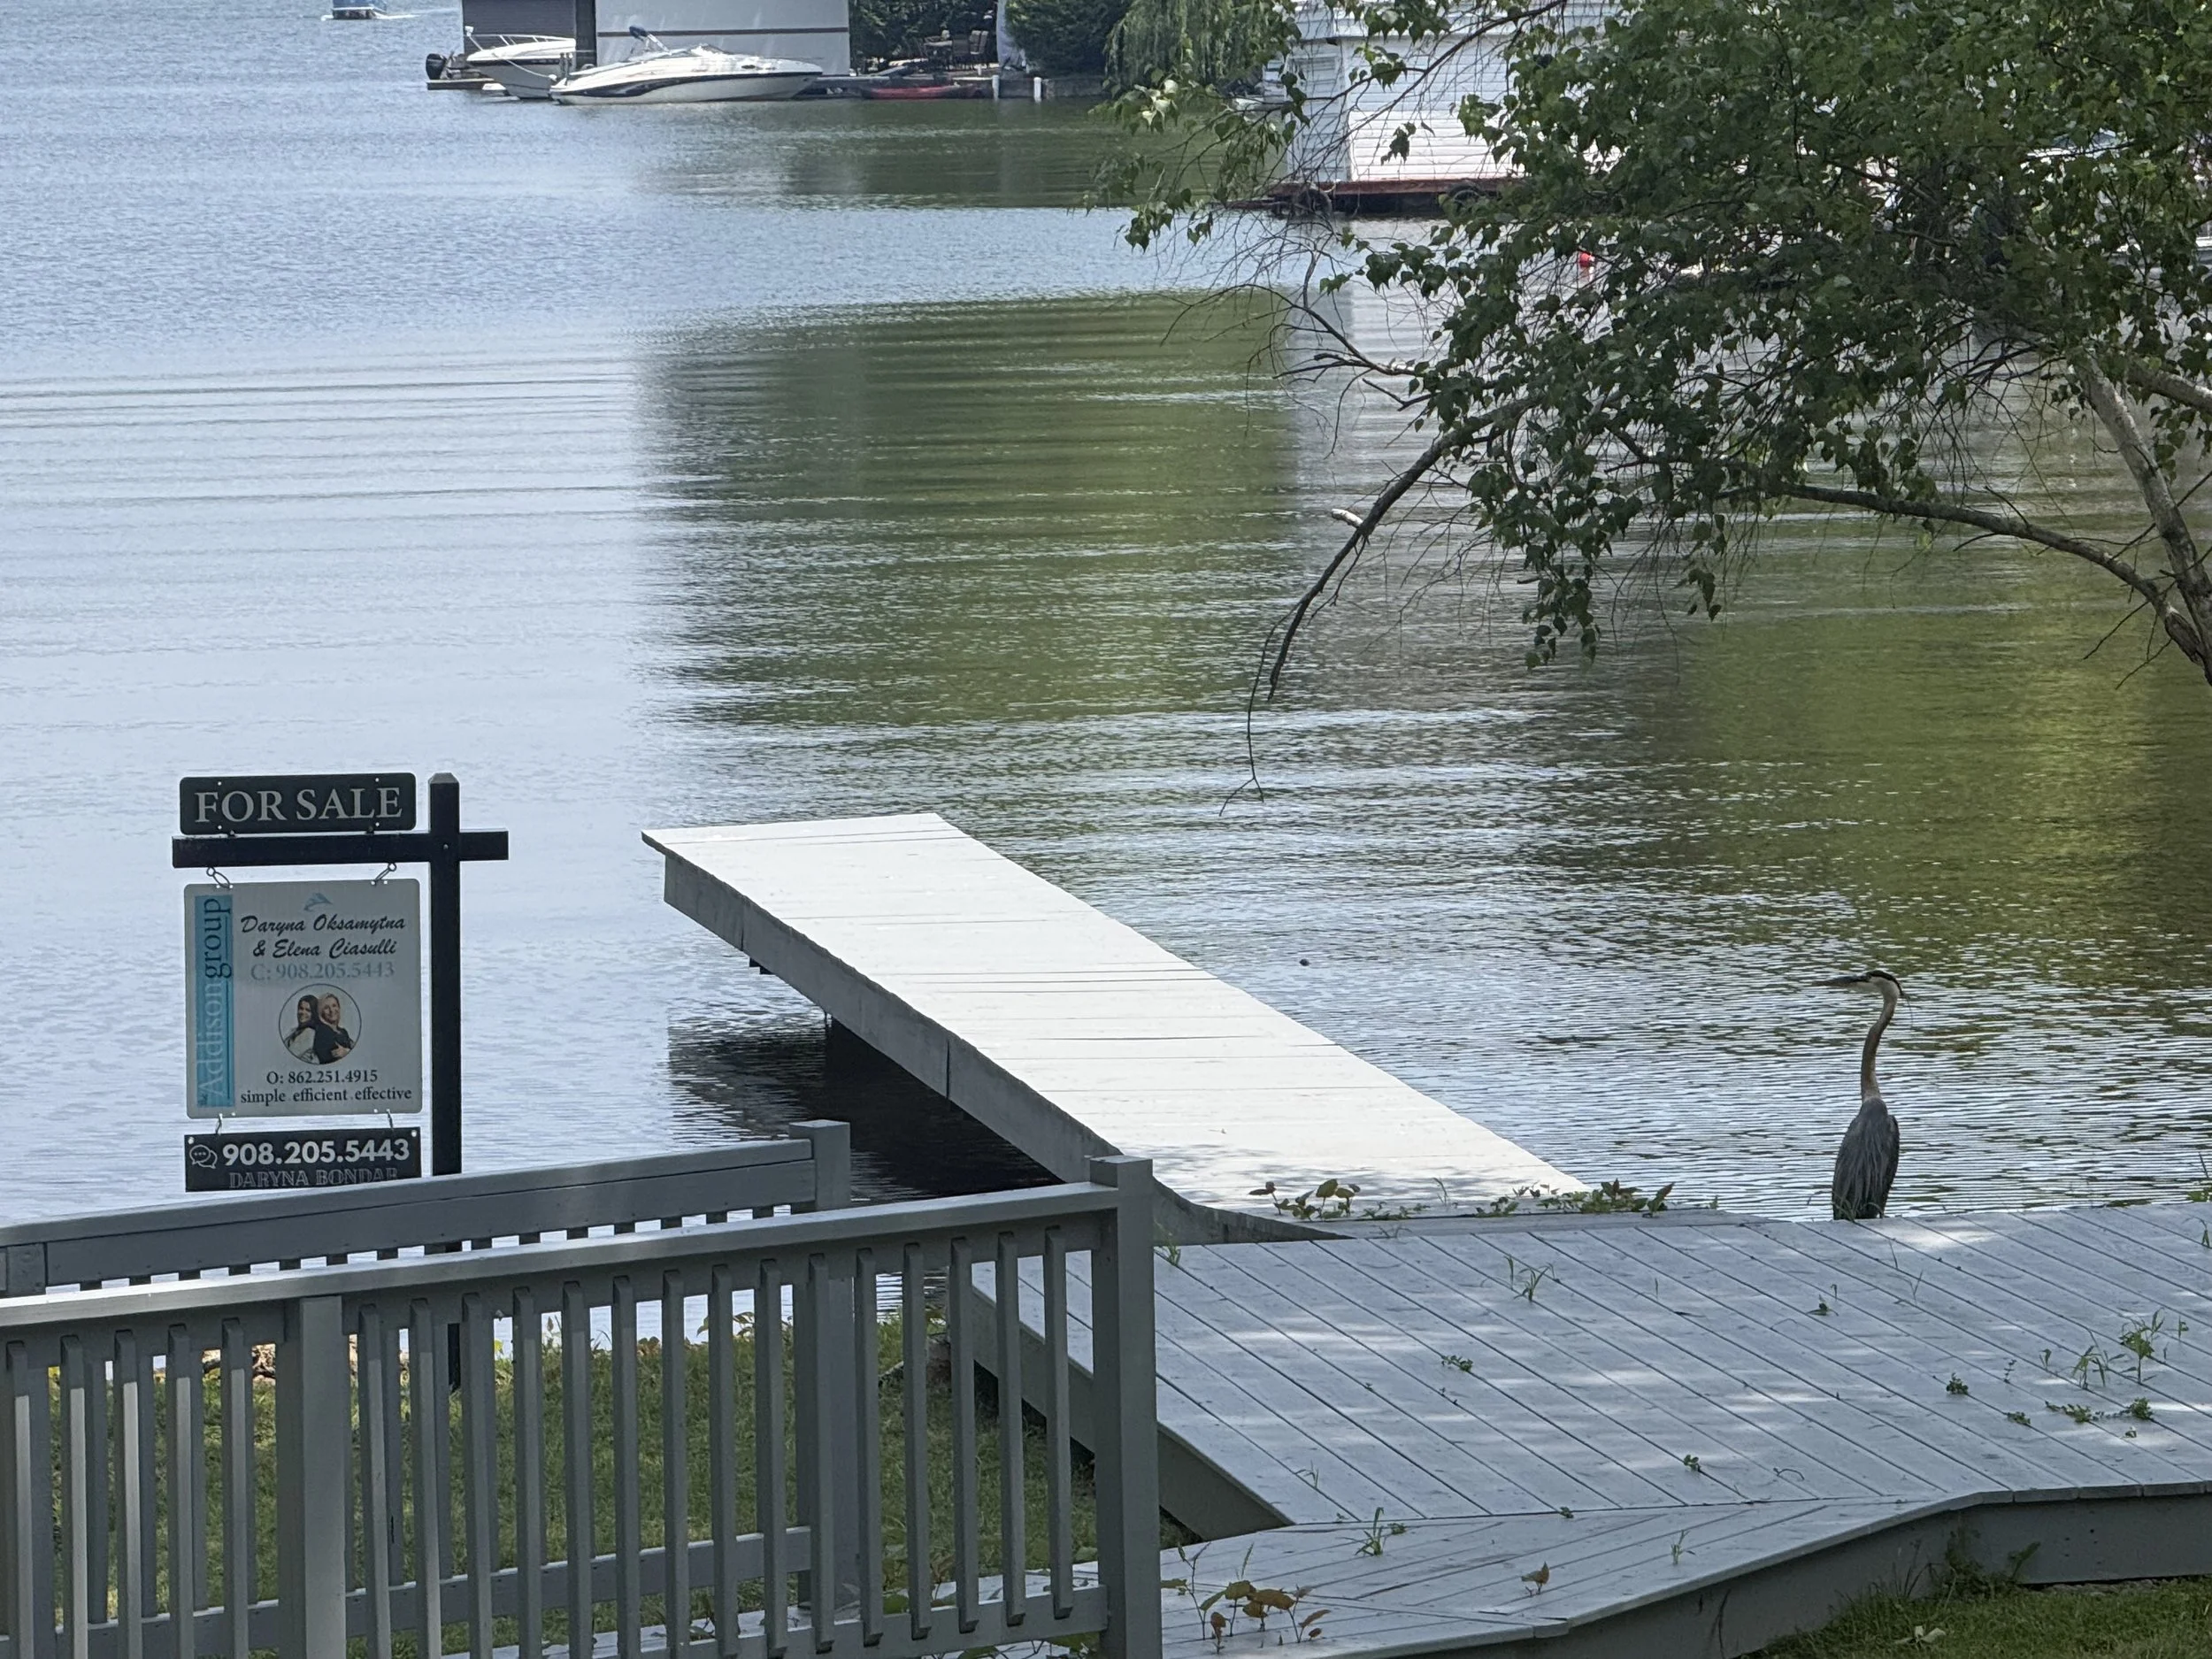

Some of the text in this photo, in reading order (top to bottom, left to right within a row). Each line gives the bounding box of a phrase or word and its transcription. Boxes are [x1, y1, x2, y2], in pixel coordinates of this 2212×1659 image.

[194, 787, 403, 823] FOR SALE
[240, 913, 406, 937] Daryna Oksamytna
[204, 898, 233, 979] group
[253, 937, 398, 959] & Elena Ciasulli
[250, 961, 396, 981] C: 908.205.5443
[196, 982, 223, 1097] Addison
[266, 1069, 379, 1085] O: 862.251.4915
[240, 1086, 412, 1106] simple efficient effective
[222, 1138, 410, 1166] 908.205.5443
[229, 1167, 398, 1189] DARYNA BONDAR
